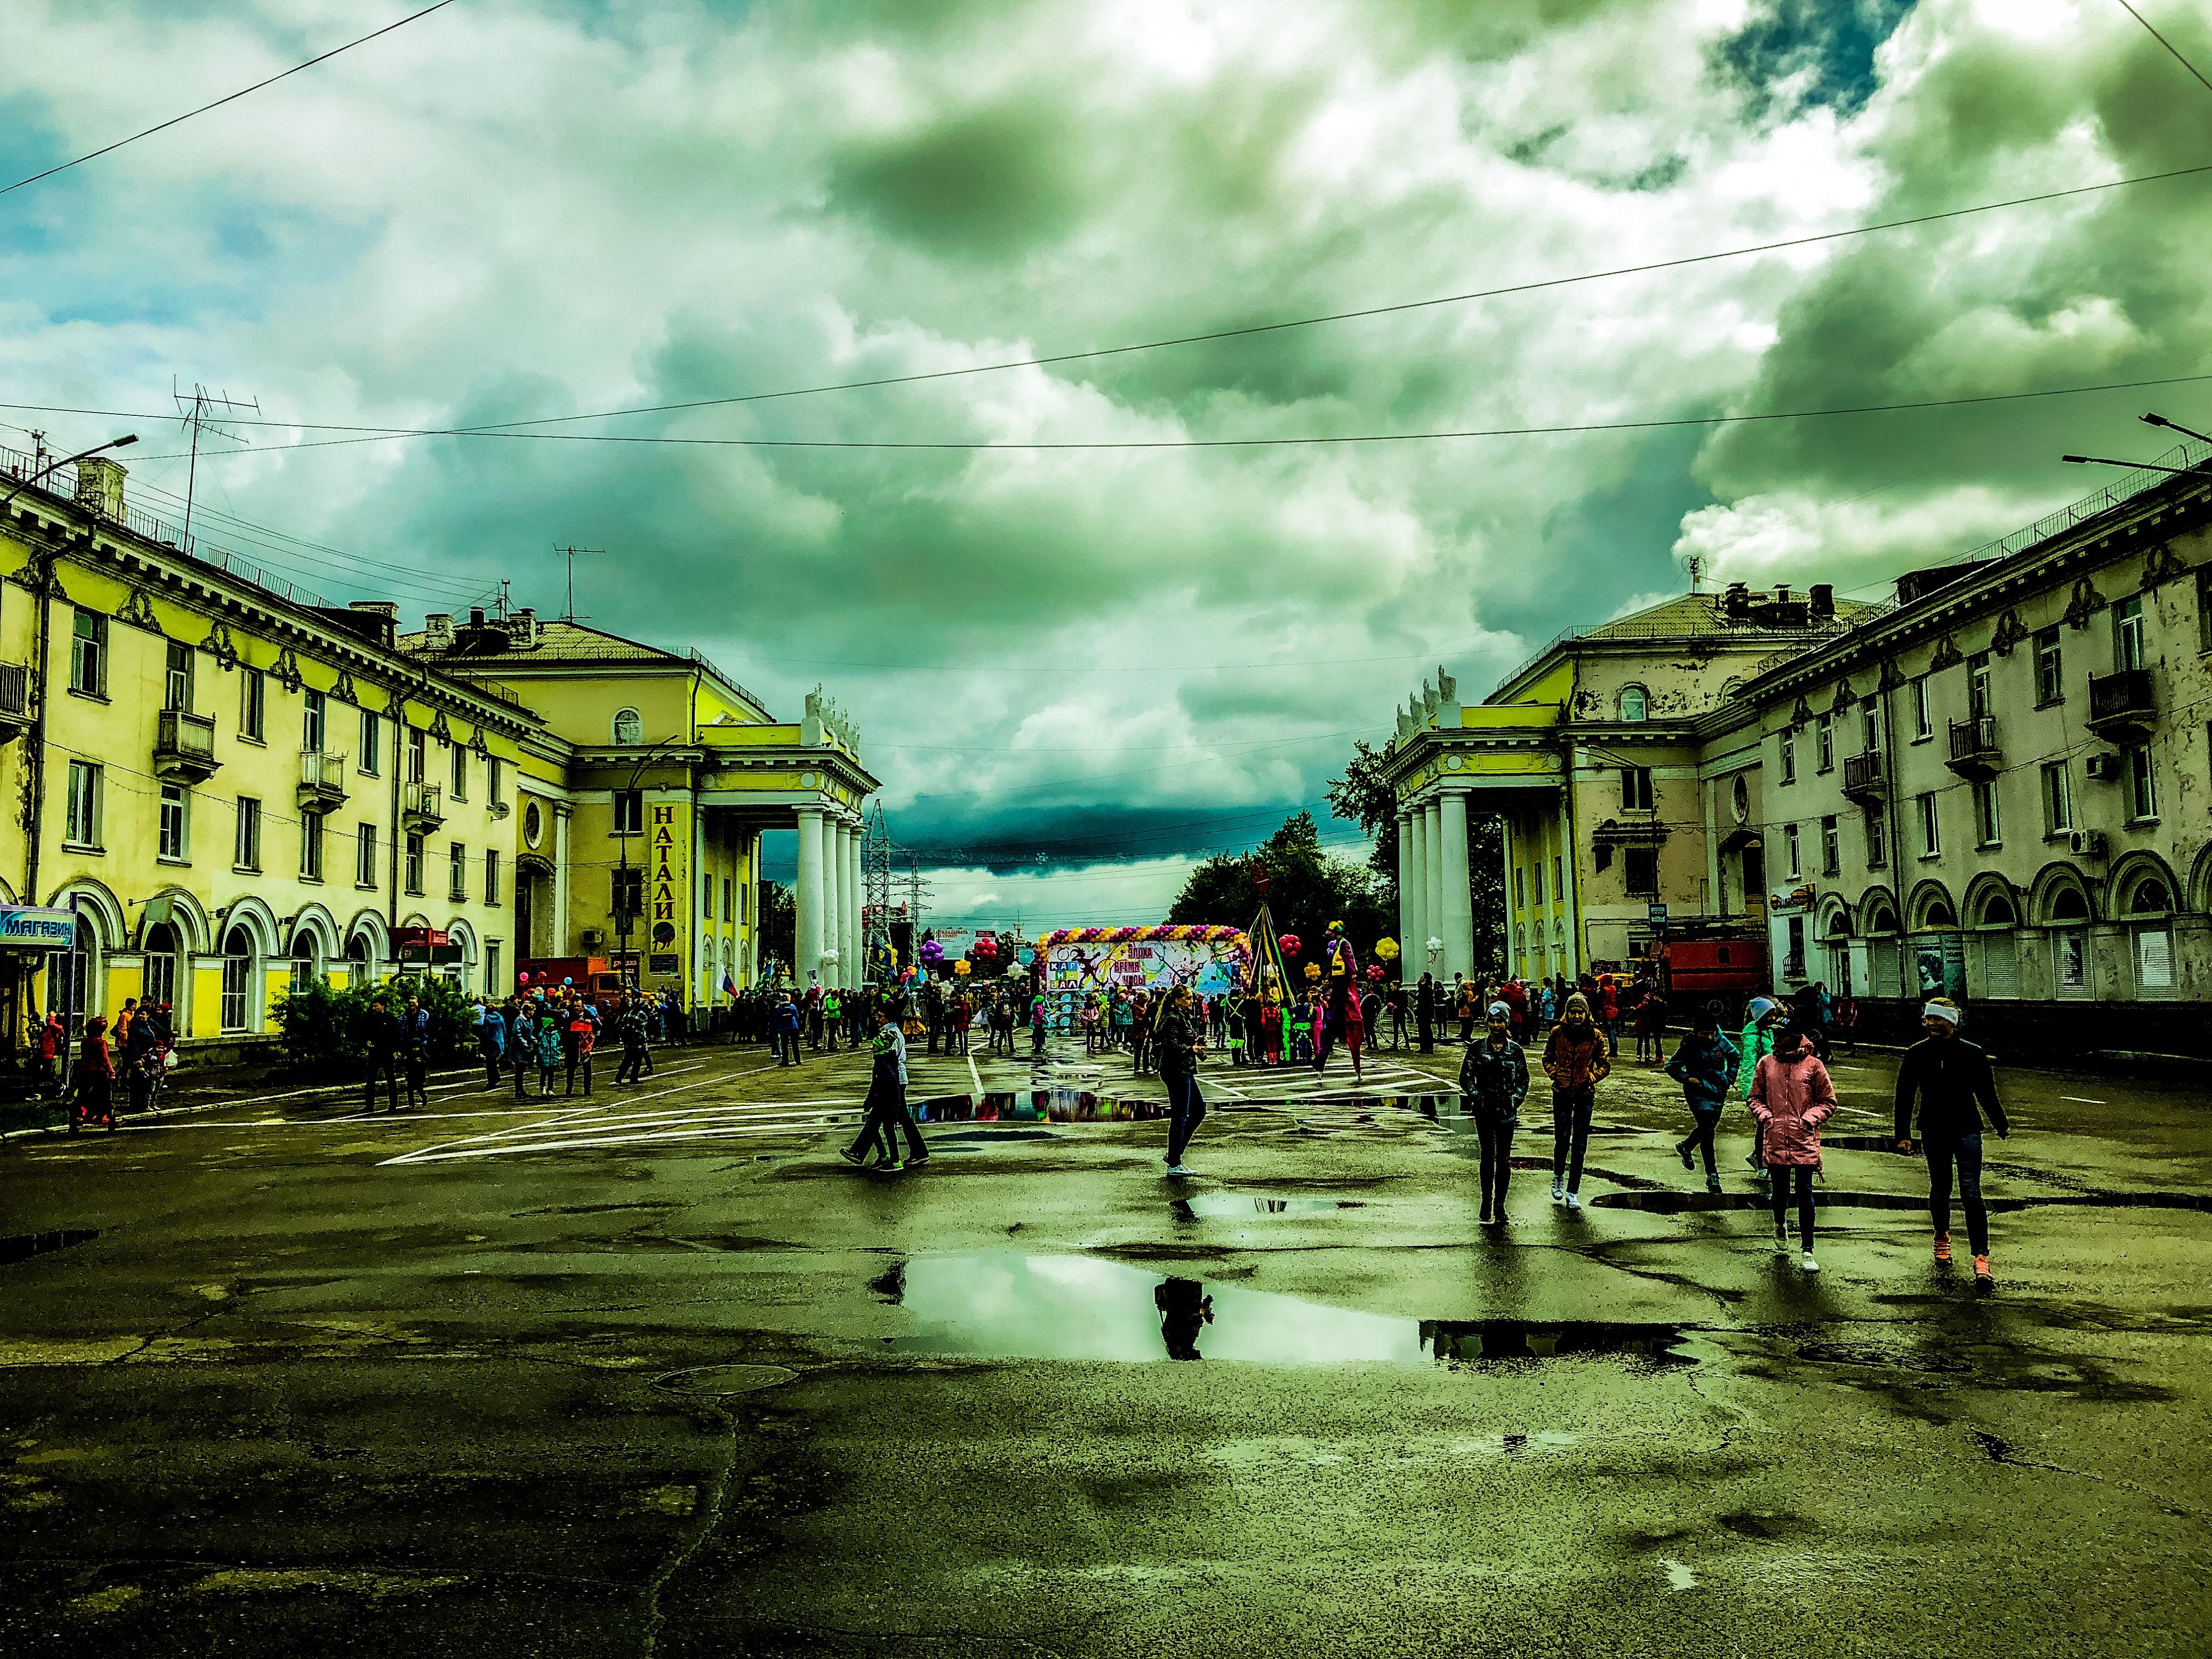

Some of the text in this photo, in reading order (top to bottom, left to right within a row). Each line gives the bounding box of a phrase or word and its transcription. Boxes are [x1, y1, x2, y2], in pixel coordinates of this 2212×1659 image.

[653, 806, 674, 920] НАТАЛИ
[5, 920, 72, 938] МАГАЗИН
[1128, 947, 1152, 958] ЭПОХА
[1050, 962, 1076, 971] КАР
[1114, 961, 1140, 973] ВРЕМЯ
[1051, 980, 1077, 989] ВАЛ
[1123, 974, 1146, 986] ЧАСЫ
